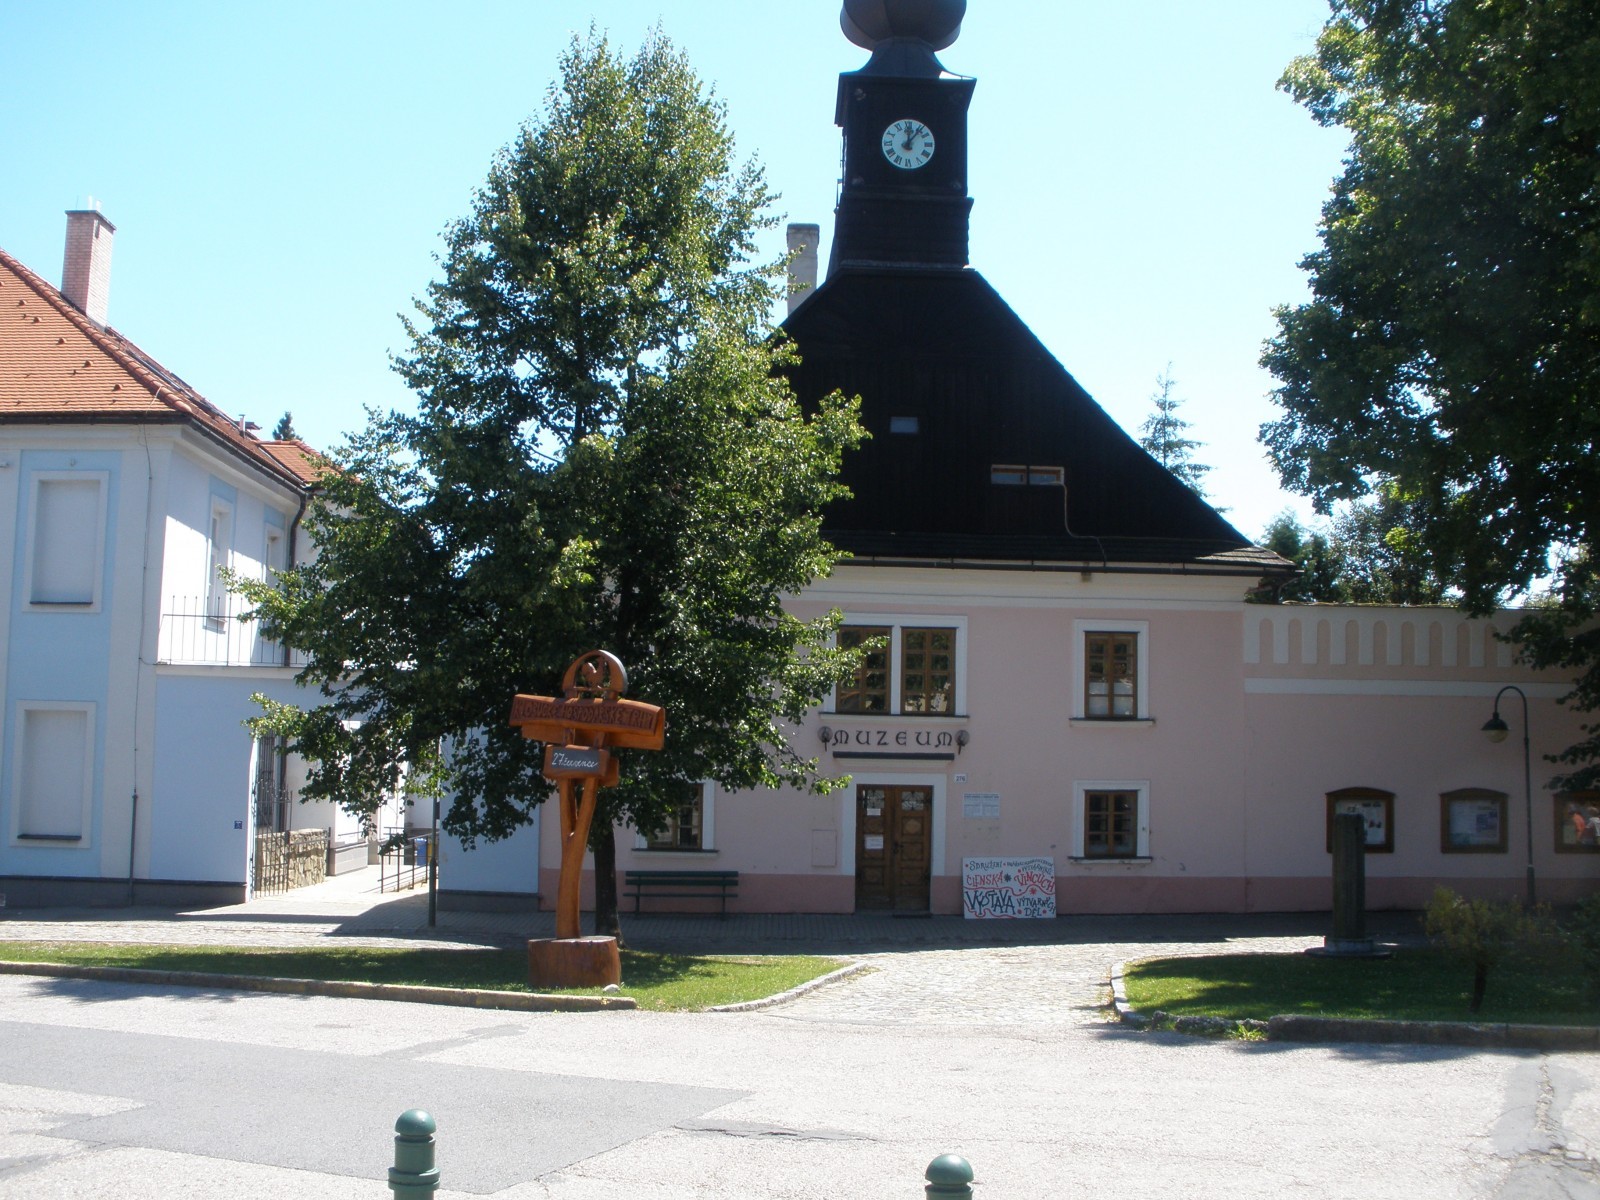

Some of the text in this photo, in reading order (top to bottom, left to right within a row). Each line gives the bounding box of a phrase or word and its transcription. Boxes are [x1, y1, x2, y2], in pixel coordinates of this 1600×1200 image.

[831, 729, 953, 748] MUZEUM
[966, 870, 1003, 887] ČLENSKÁ
[965, 889, 1016, 915] VÝSTAVA
[1016, 896, 1056, 914] VÝTVARNÝCH
